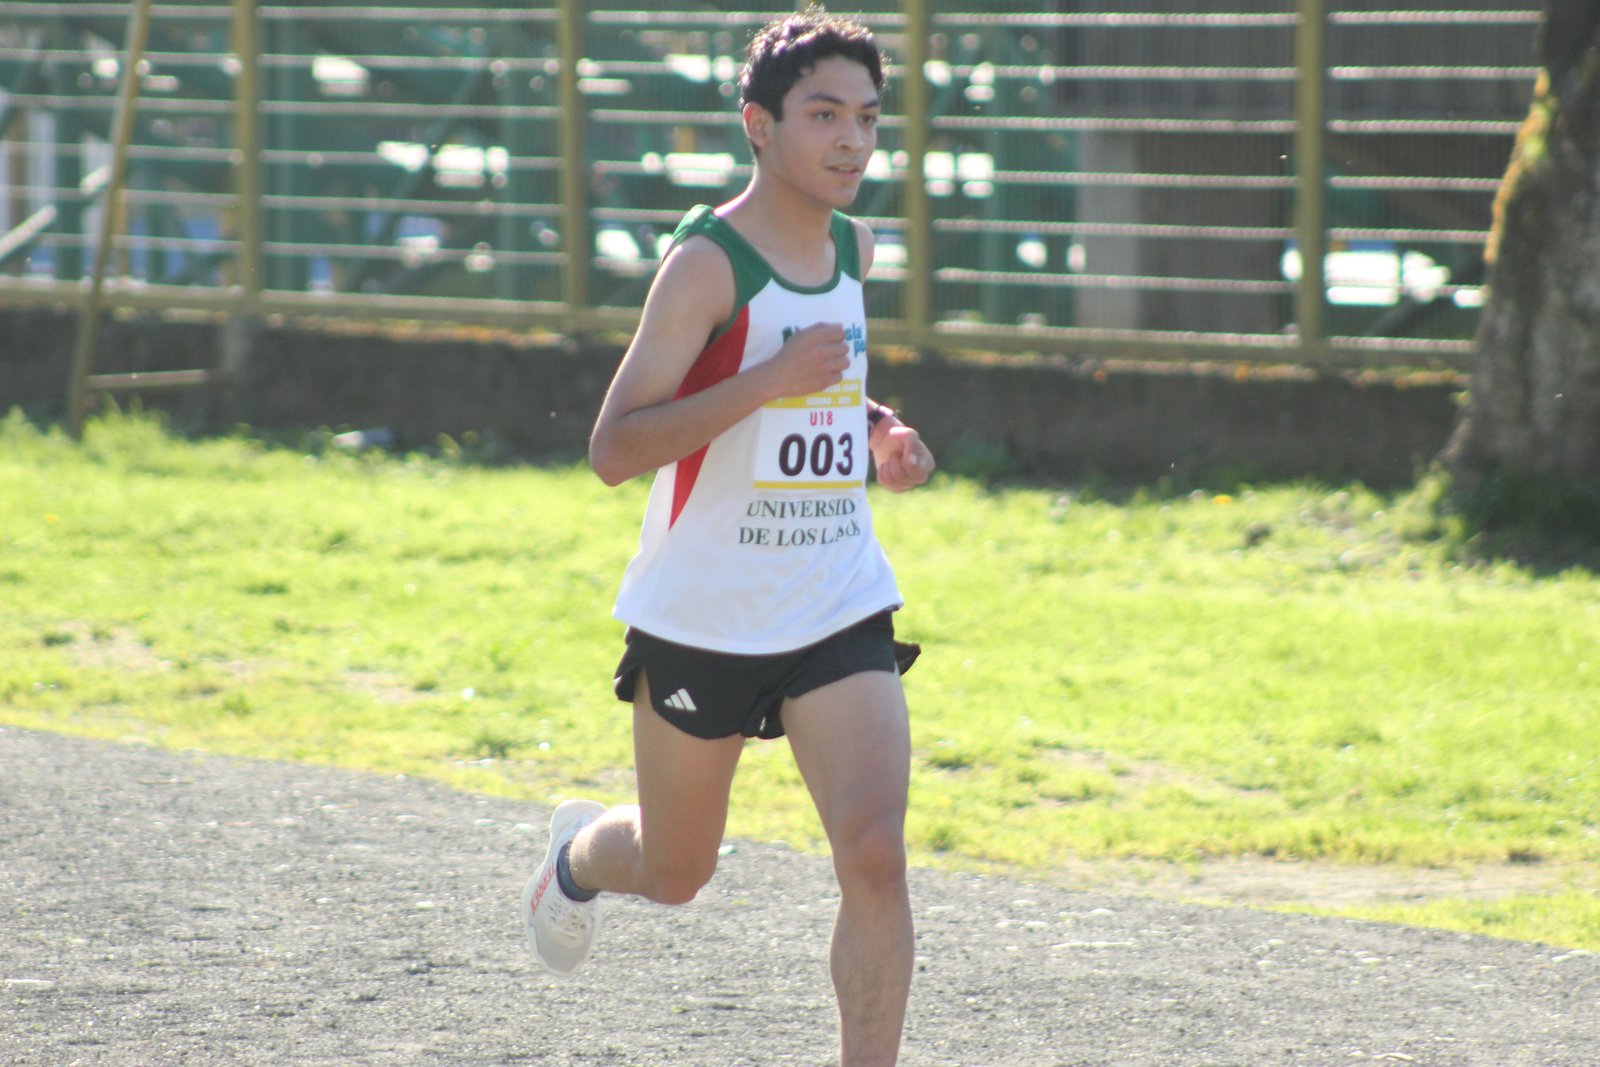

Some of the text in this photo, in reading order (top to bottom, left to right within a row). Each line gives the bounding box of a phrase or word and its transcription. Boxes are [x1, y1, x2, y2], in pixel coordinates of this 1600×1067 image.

[810, 411, 833, 426] U18
[779, 432, 853, 477] 003
[738, 527, 770, 545] DE
[776, 528, 817, 546] LOS
